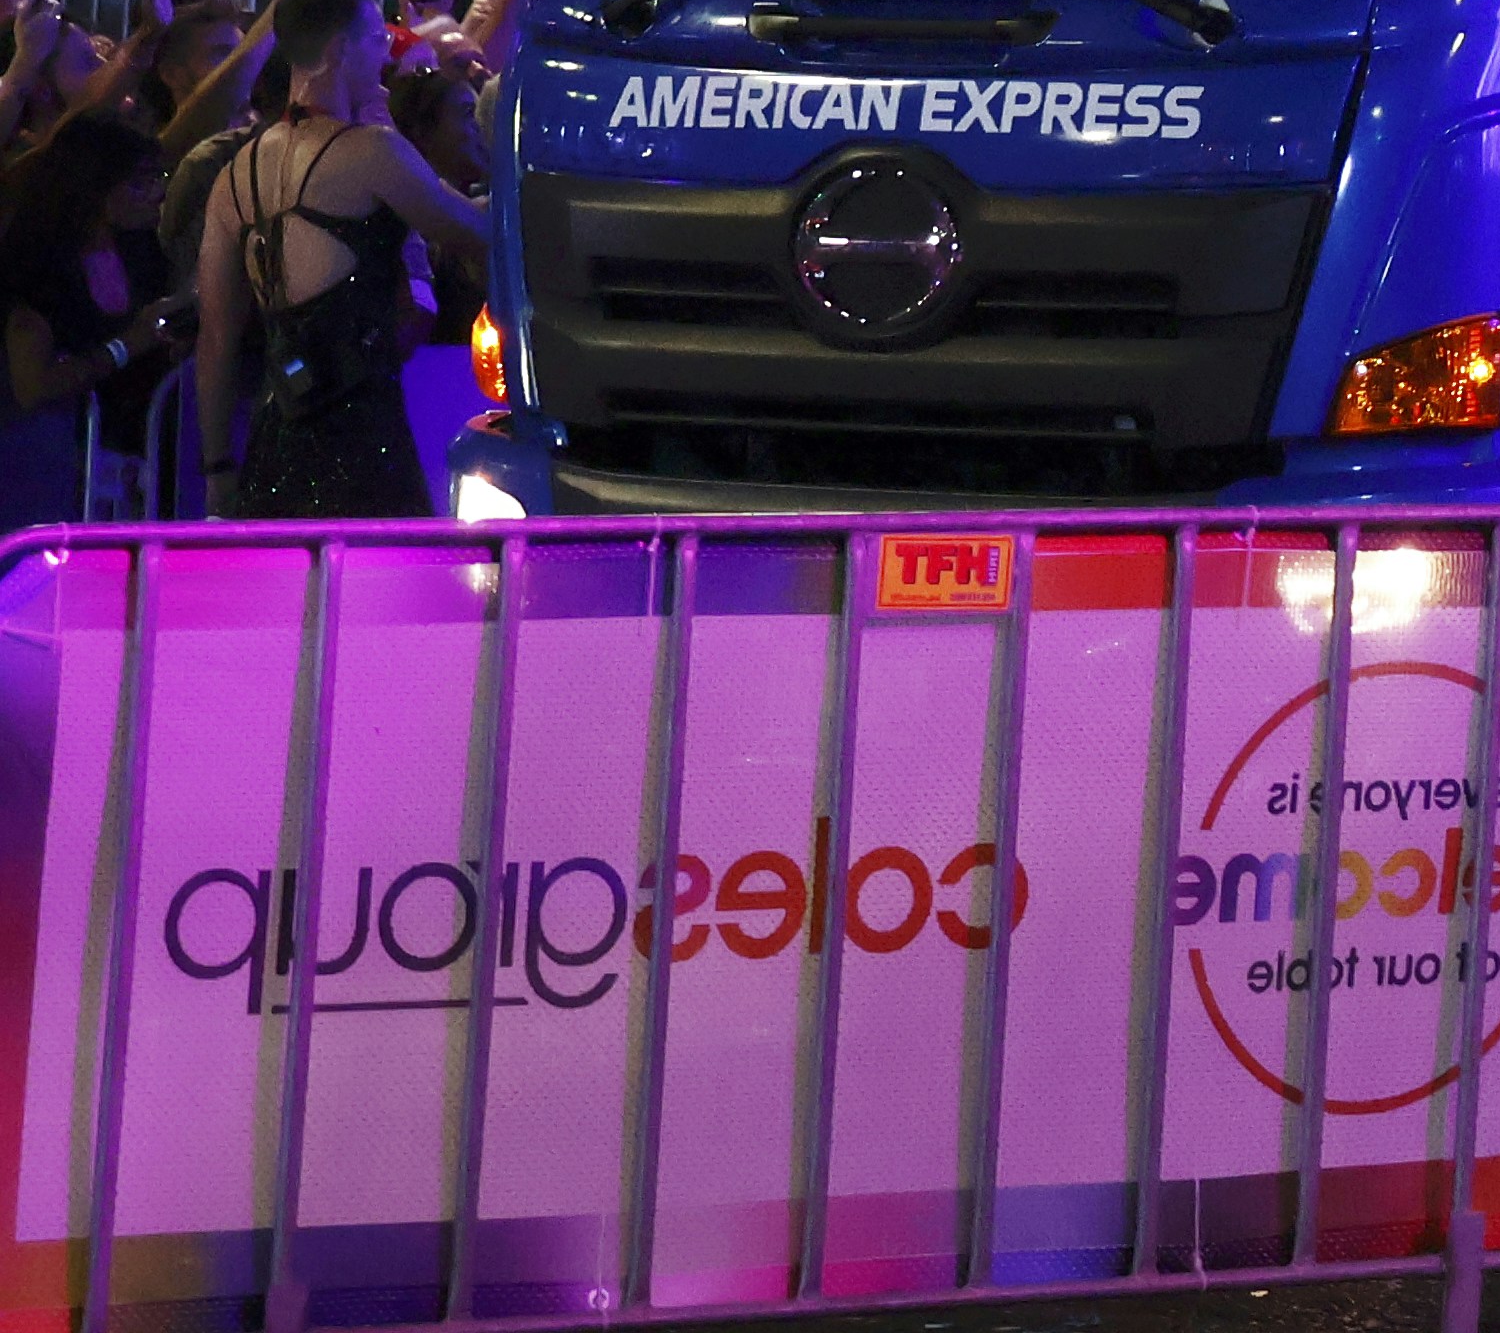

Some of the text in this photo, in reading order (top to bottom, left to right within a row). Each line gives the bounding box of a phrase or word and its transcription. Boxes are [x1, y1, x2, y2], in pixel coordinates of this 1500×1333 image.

[609, 74, 1204, 140] AMERICAN EXPRESS
[895, 543, 989, 585] TFH
